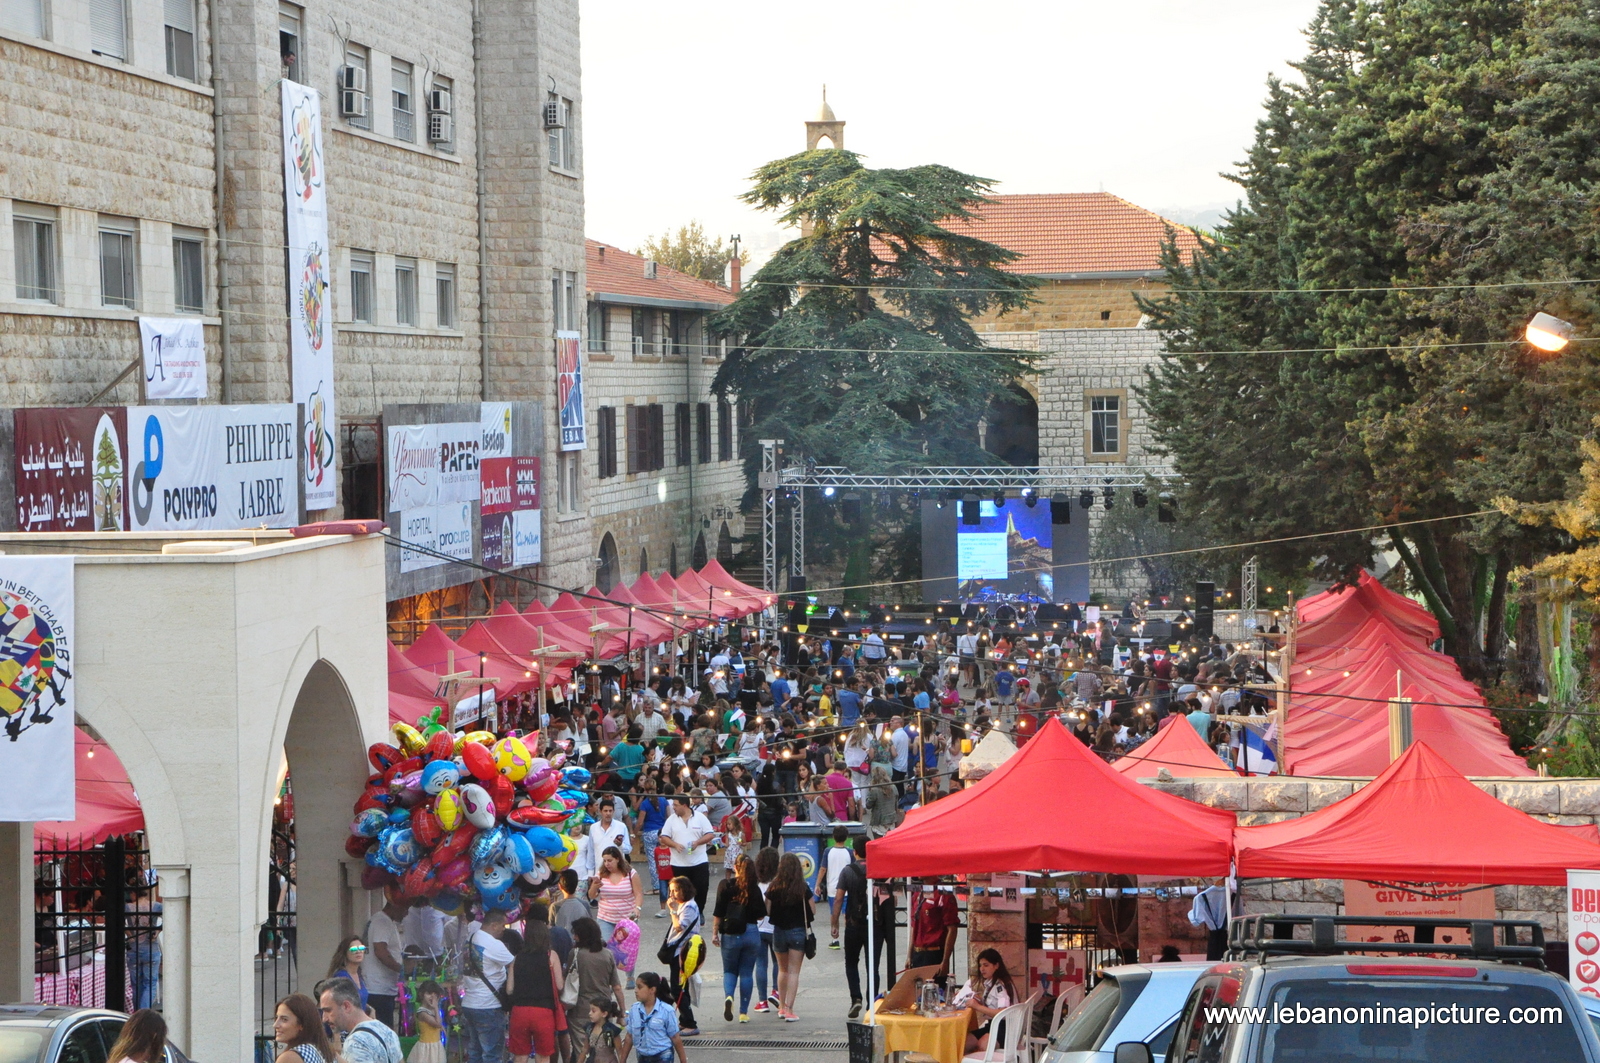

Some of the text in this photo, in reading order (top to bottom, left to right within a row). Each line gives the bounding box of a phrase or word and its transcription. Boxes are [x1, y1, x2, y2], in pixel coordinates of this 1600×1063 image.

[22, 437, 85, 479] بلدية بيت شباب
[225, 422, 293, 465] PHILIPPE
[441, 440, 479, 473] PAPEC
[164, 484, 217, 522] POLYPRO
[238, 477, 286, 521] JABRE
[440, 530, 470, 550] procure
[5, 580, 70, 662] IN BEIT CHABEB
[1375, 891, 1417, 903] GIVE
[1422, 889, 1463, 902] LIFE!
[1573, 913, 1582, 921] of
